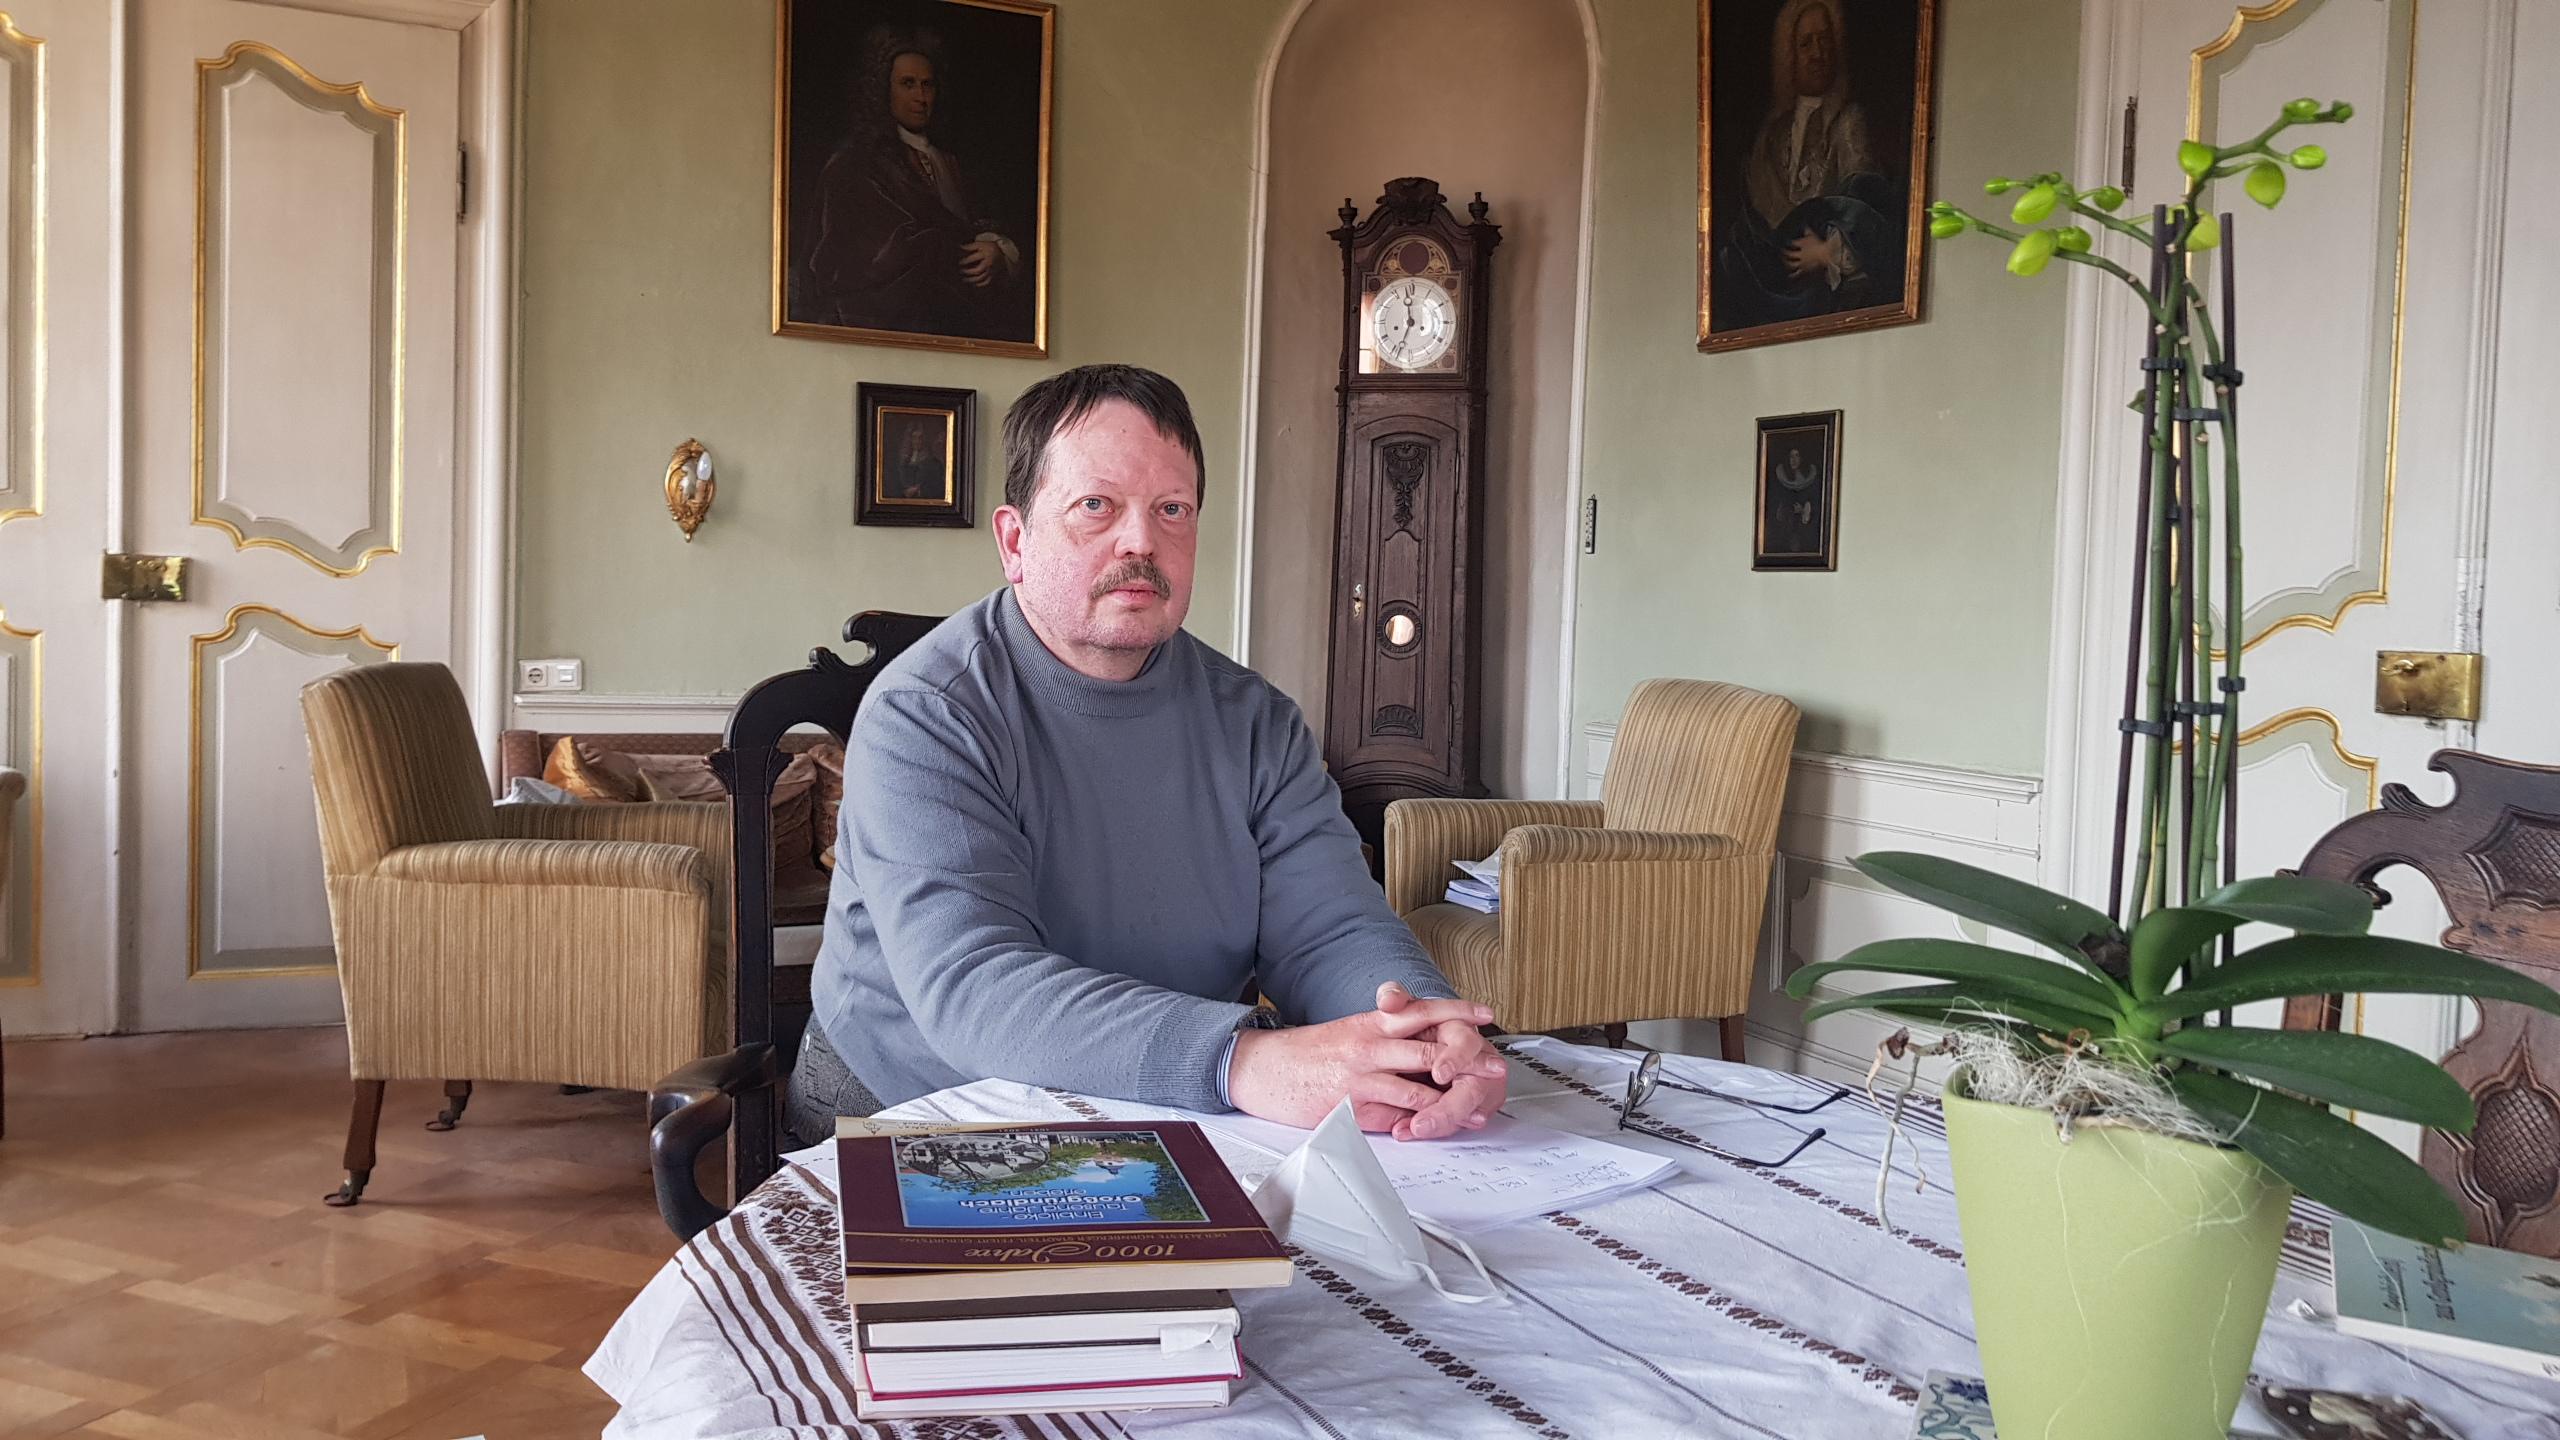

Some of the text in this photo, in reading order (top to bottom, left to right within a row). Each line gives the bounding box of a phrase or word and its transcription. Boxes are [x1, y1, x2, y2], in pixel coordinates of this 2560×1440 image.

[959, 1195, 1143, 1208] Großgründlach
[978, 1203, 1128, 1214] Tausend Jahre
[1012, 1211, 1104, 1221] Einblicke
[964, 1242, 1176, 1263] 1000 Jahre
